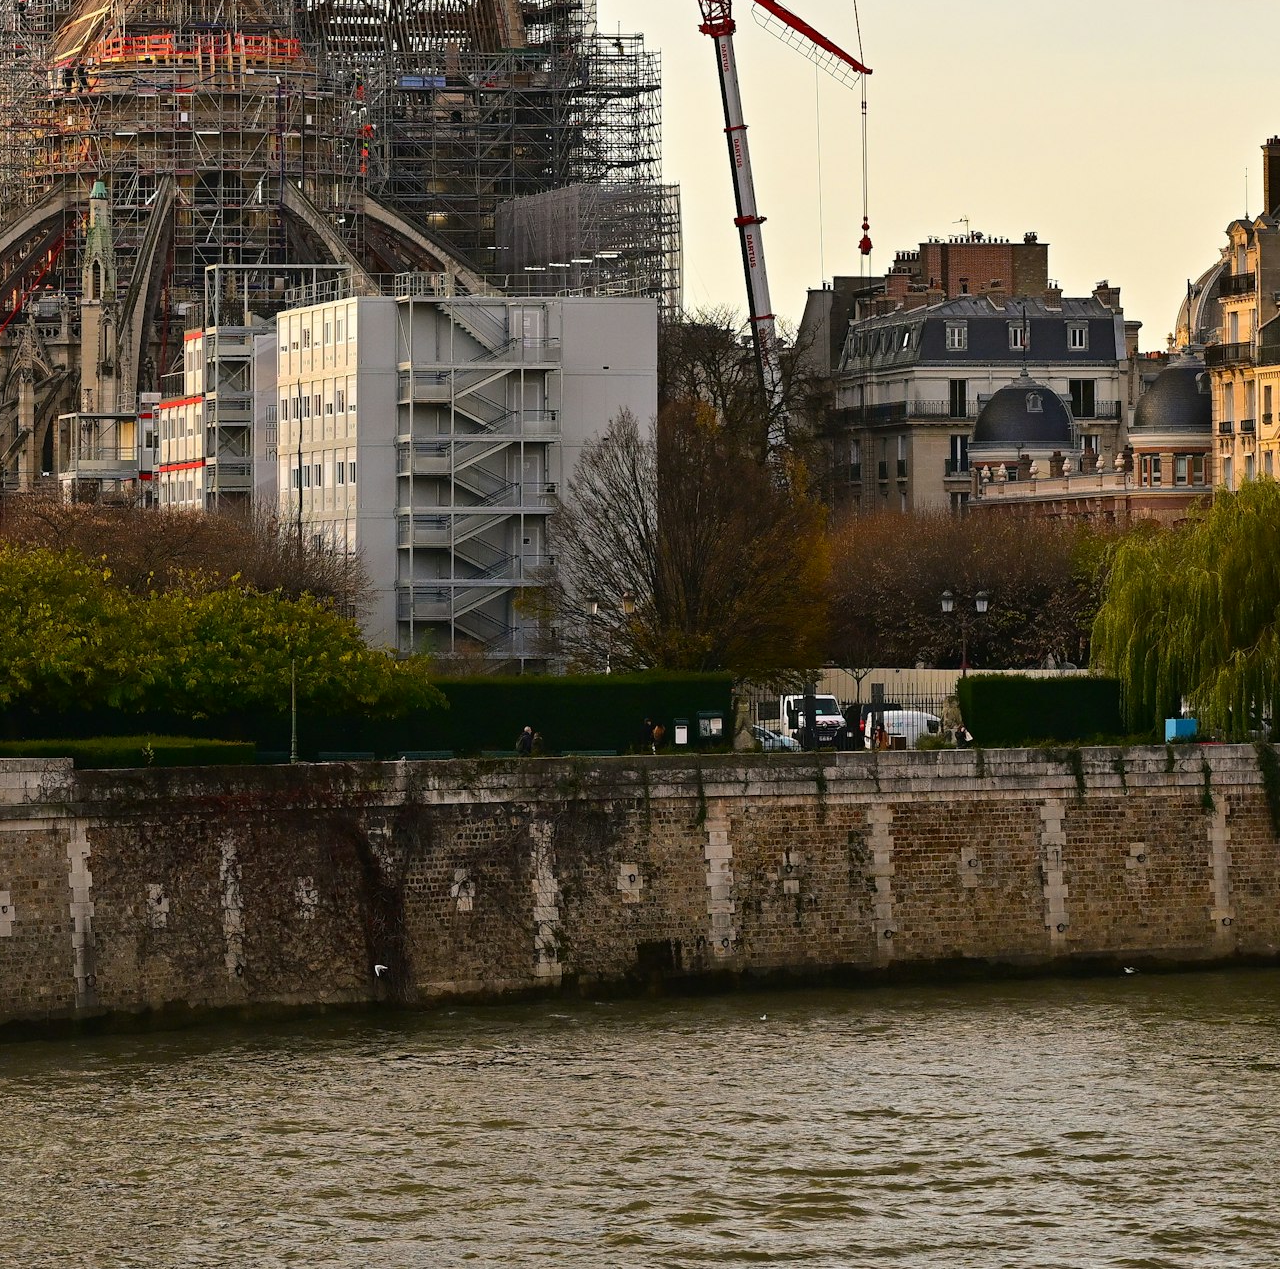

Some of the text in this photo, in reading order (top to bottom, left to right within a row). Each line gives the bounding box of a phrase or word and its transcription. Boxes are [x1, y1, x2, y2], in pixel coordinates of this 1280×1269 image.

[720, 43, 730, 73] DARTUS
[733, 138, 743, 169] DARTUS
[746, 234, 757, 268] DARTUS
